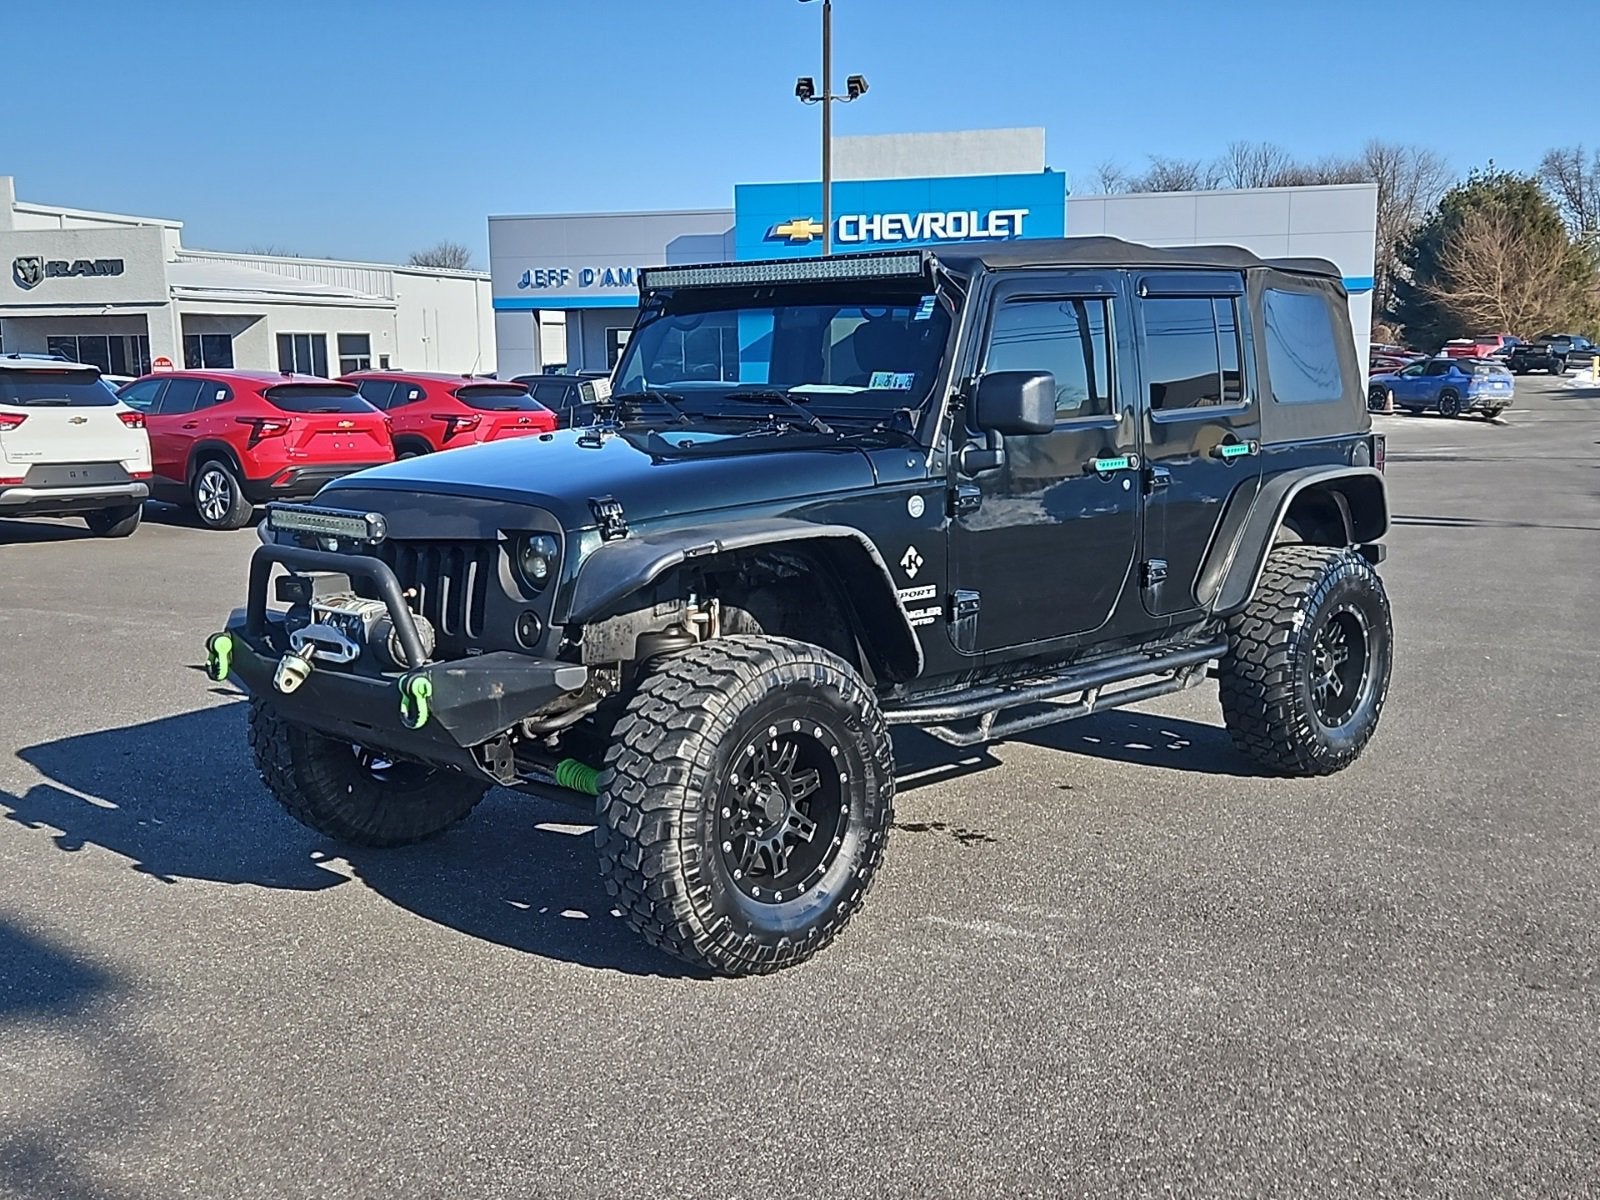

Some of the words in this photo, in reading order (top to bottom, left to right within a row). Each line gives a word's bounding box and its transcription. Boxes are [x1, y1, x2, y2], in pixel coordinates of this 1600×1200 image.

[836, 208, 1030, 242] CHEVROLET
[45, 259, 124, 278] RAM
[518, 267, 570, 288] JEFF
[899, 588, 935, 599] PORT
